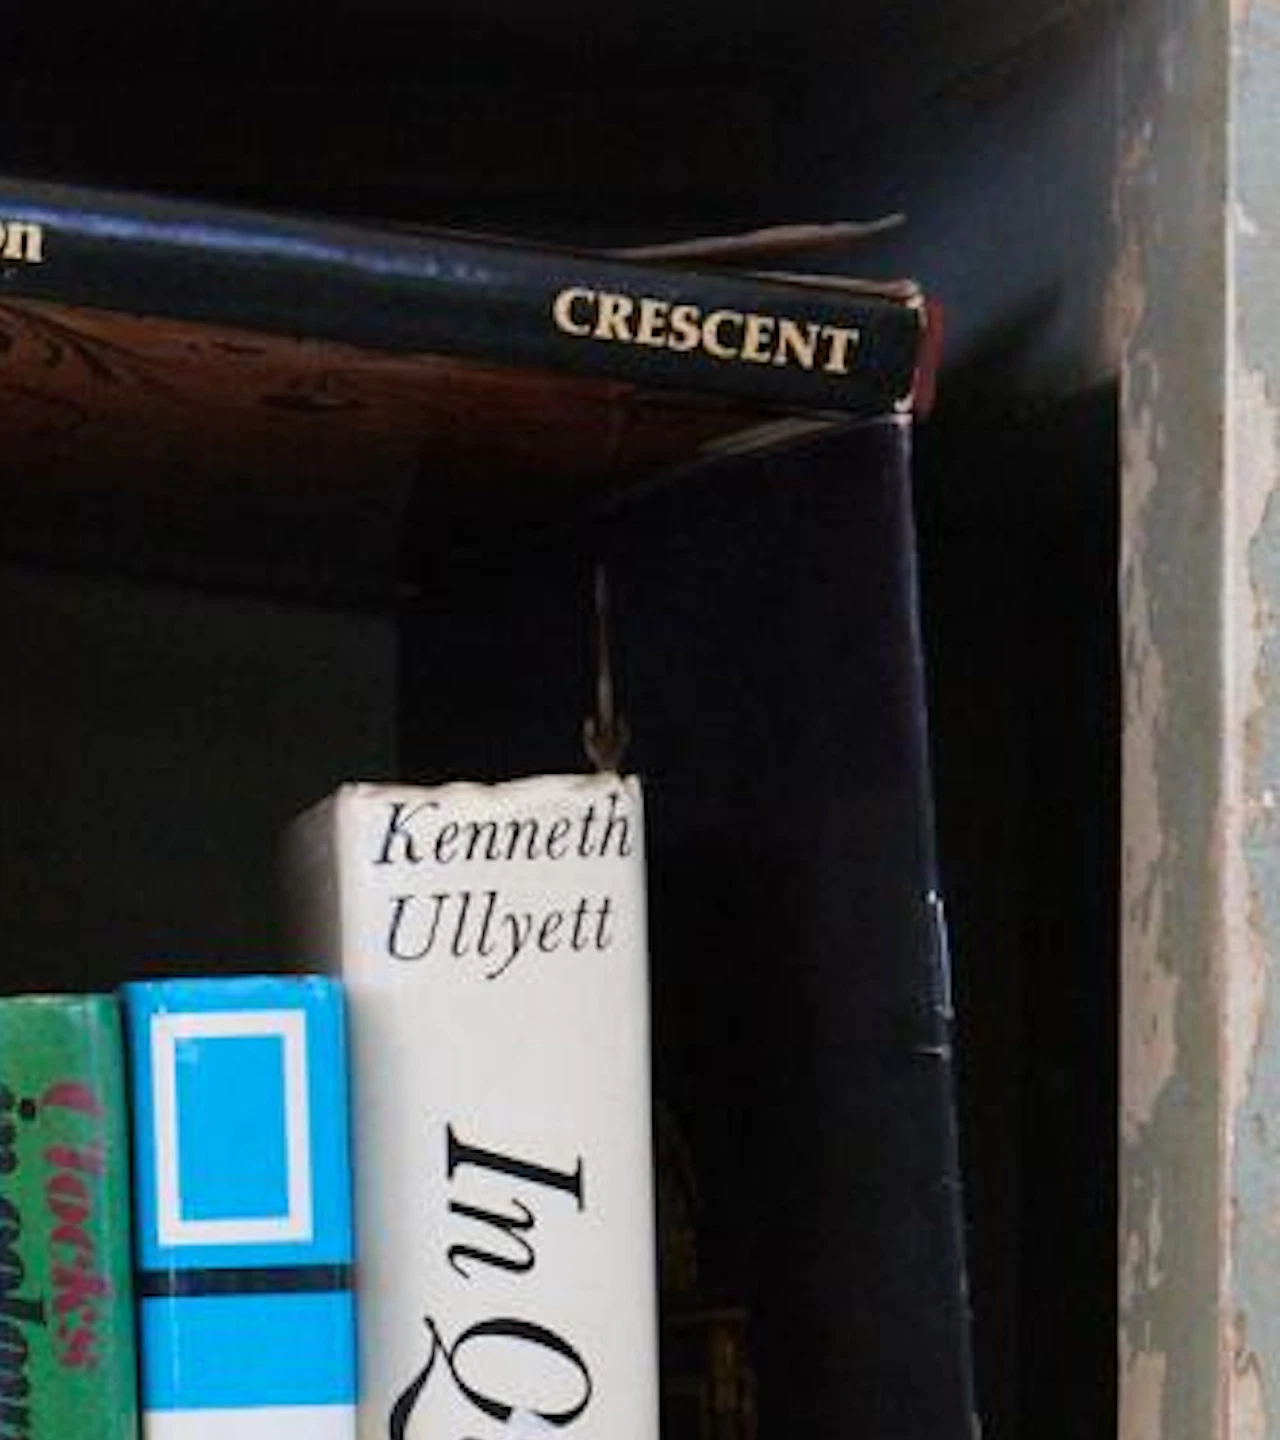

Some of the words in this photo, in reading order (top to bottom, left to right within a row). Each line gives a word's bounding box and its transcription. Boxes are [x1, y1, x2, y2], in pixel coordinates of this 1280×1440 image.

[553, 286, 860, 375] CRESCENT
[373, 792, 632, 865] Kenneth
[387, 890, 615, 980] Ullyett
[446, 1122, 585, 1279] In
